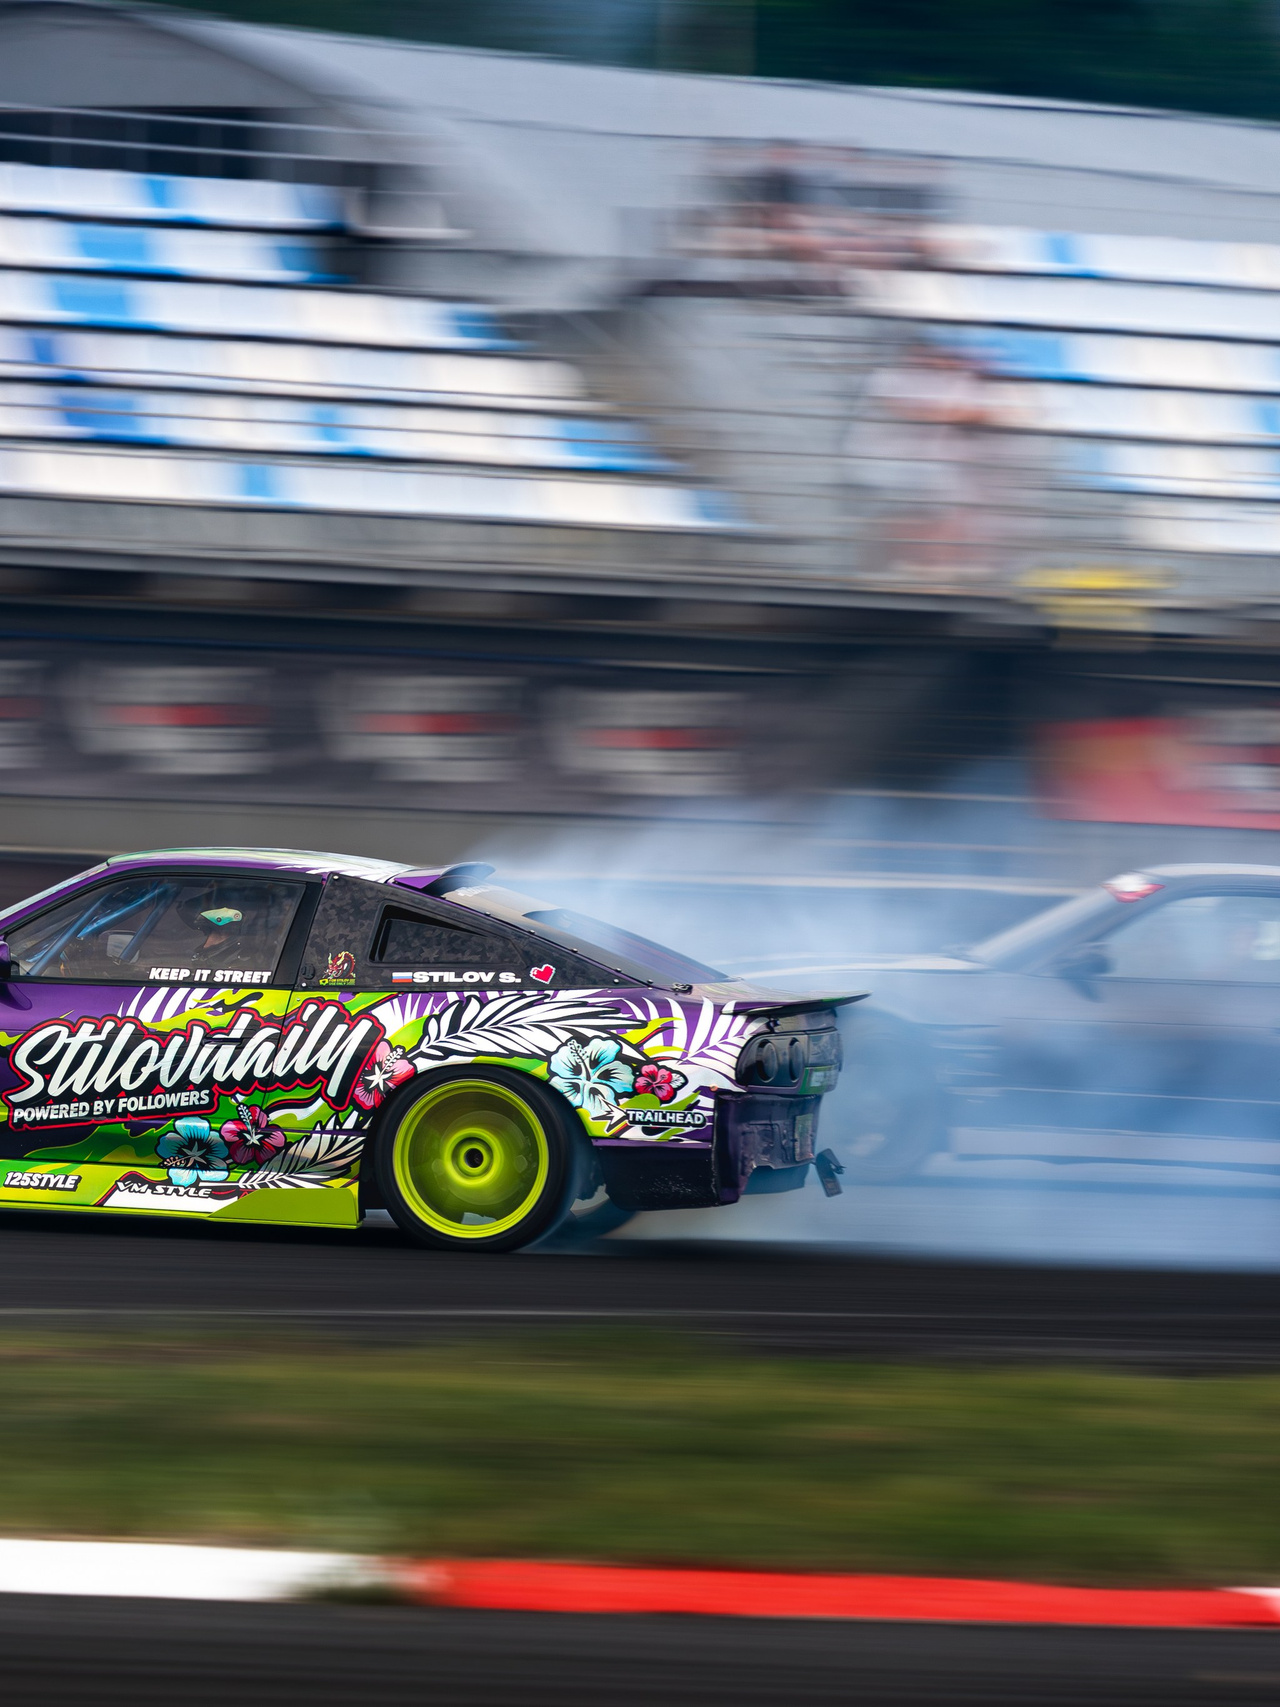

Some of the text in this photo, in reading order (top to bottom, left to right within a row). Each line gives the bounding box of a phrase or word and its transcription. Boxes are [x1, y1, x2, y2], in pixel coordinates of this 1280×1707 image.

[149, 967, 272, 984] KEEP IT STREET
[412, 971, 521, 983] STILOV S.
[13, 1089, 210, 1123] POWERED BY FOLLOWERS
[627, 1110, 704, 1124] TRAILHEAD
[5, 1172, 79, 1189] 125STYLE
